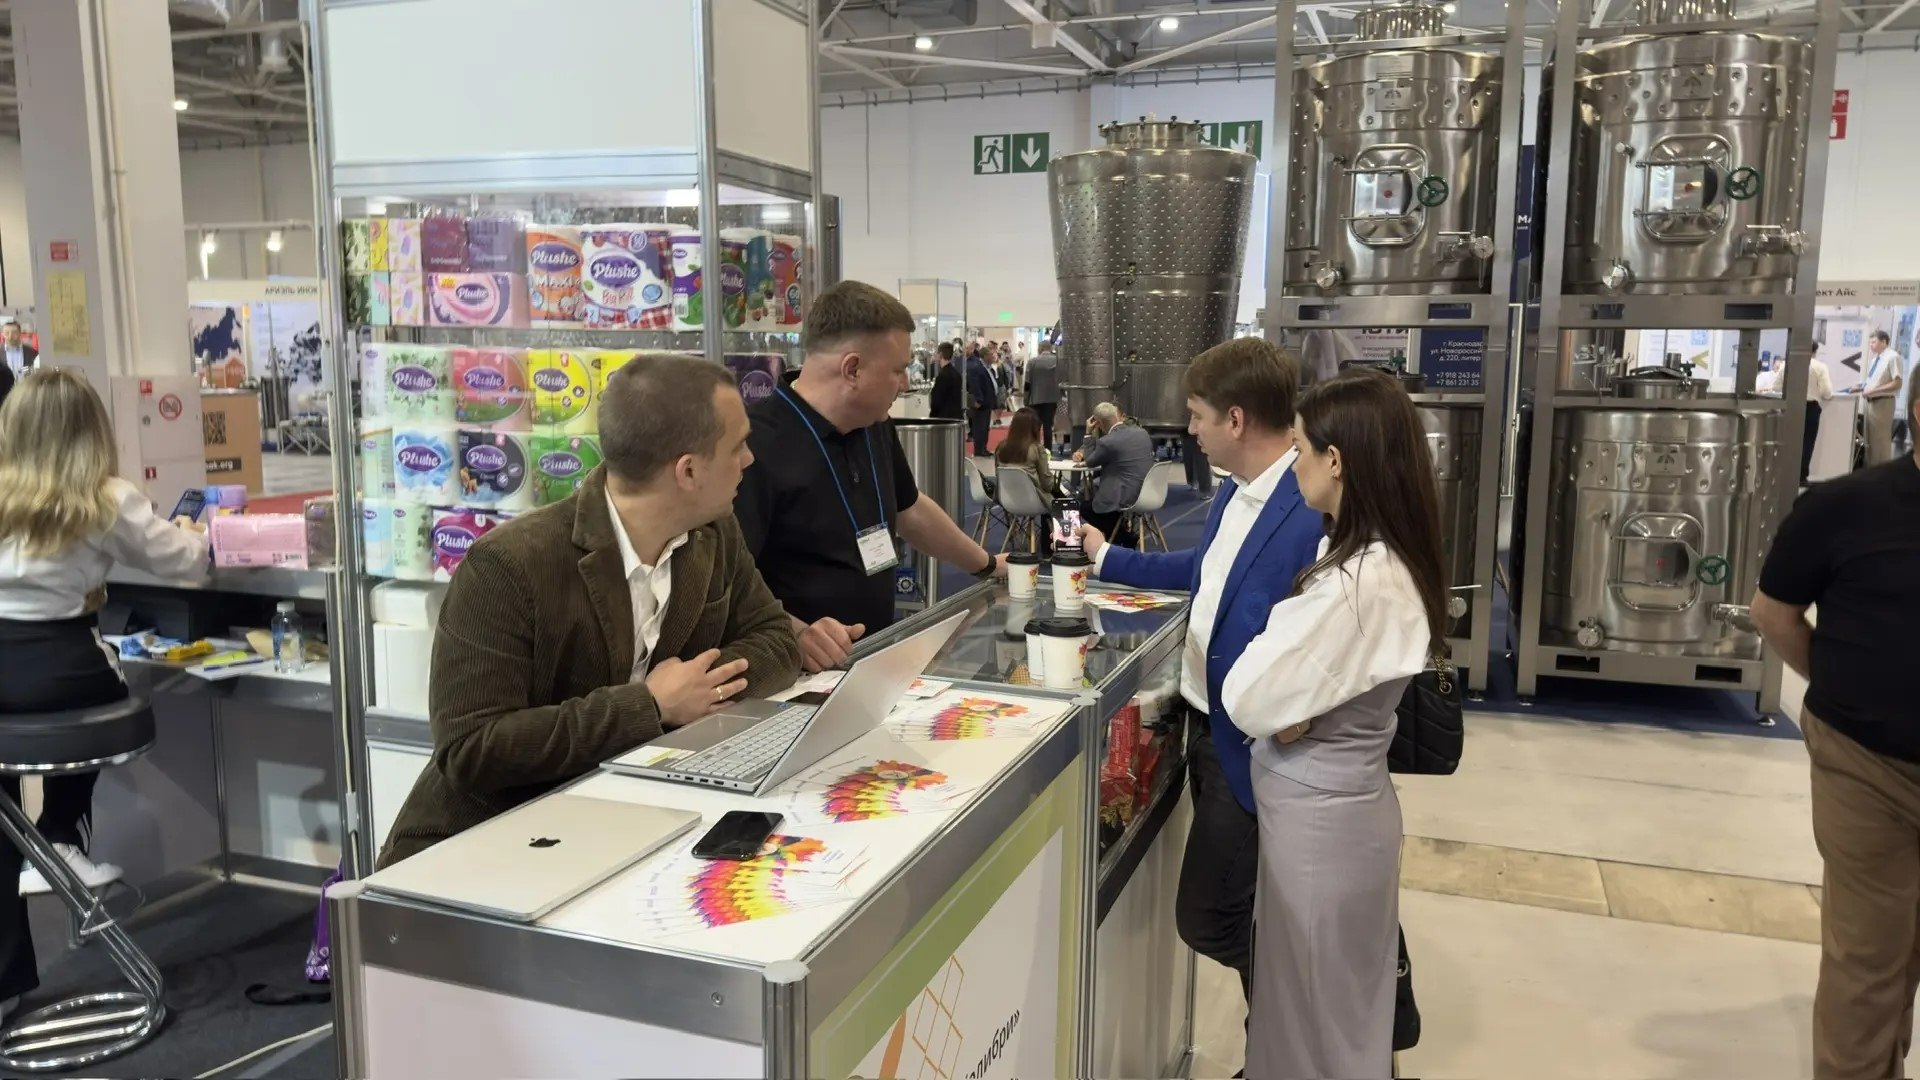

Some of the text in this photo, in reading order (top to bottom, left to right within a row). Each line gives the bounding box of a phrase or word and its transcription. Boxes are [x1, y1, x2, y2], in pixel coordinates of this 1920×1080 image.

[530, 250, 577, 265] Plushe
[591, 262, 639, 279] Plushe
[457, 286, 488, 299] Plushe
[394, 371, 433, 387] Plushe
[467, 372, 502, 387] Plushe
[400, 451, 439, 467] Plushe
[470, 451, 504, 466] Plushe
[541, 459, 580, 472] Plushe
[437, 532, 474, 549] Plushe
